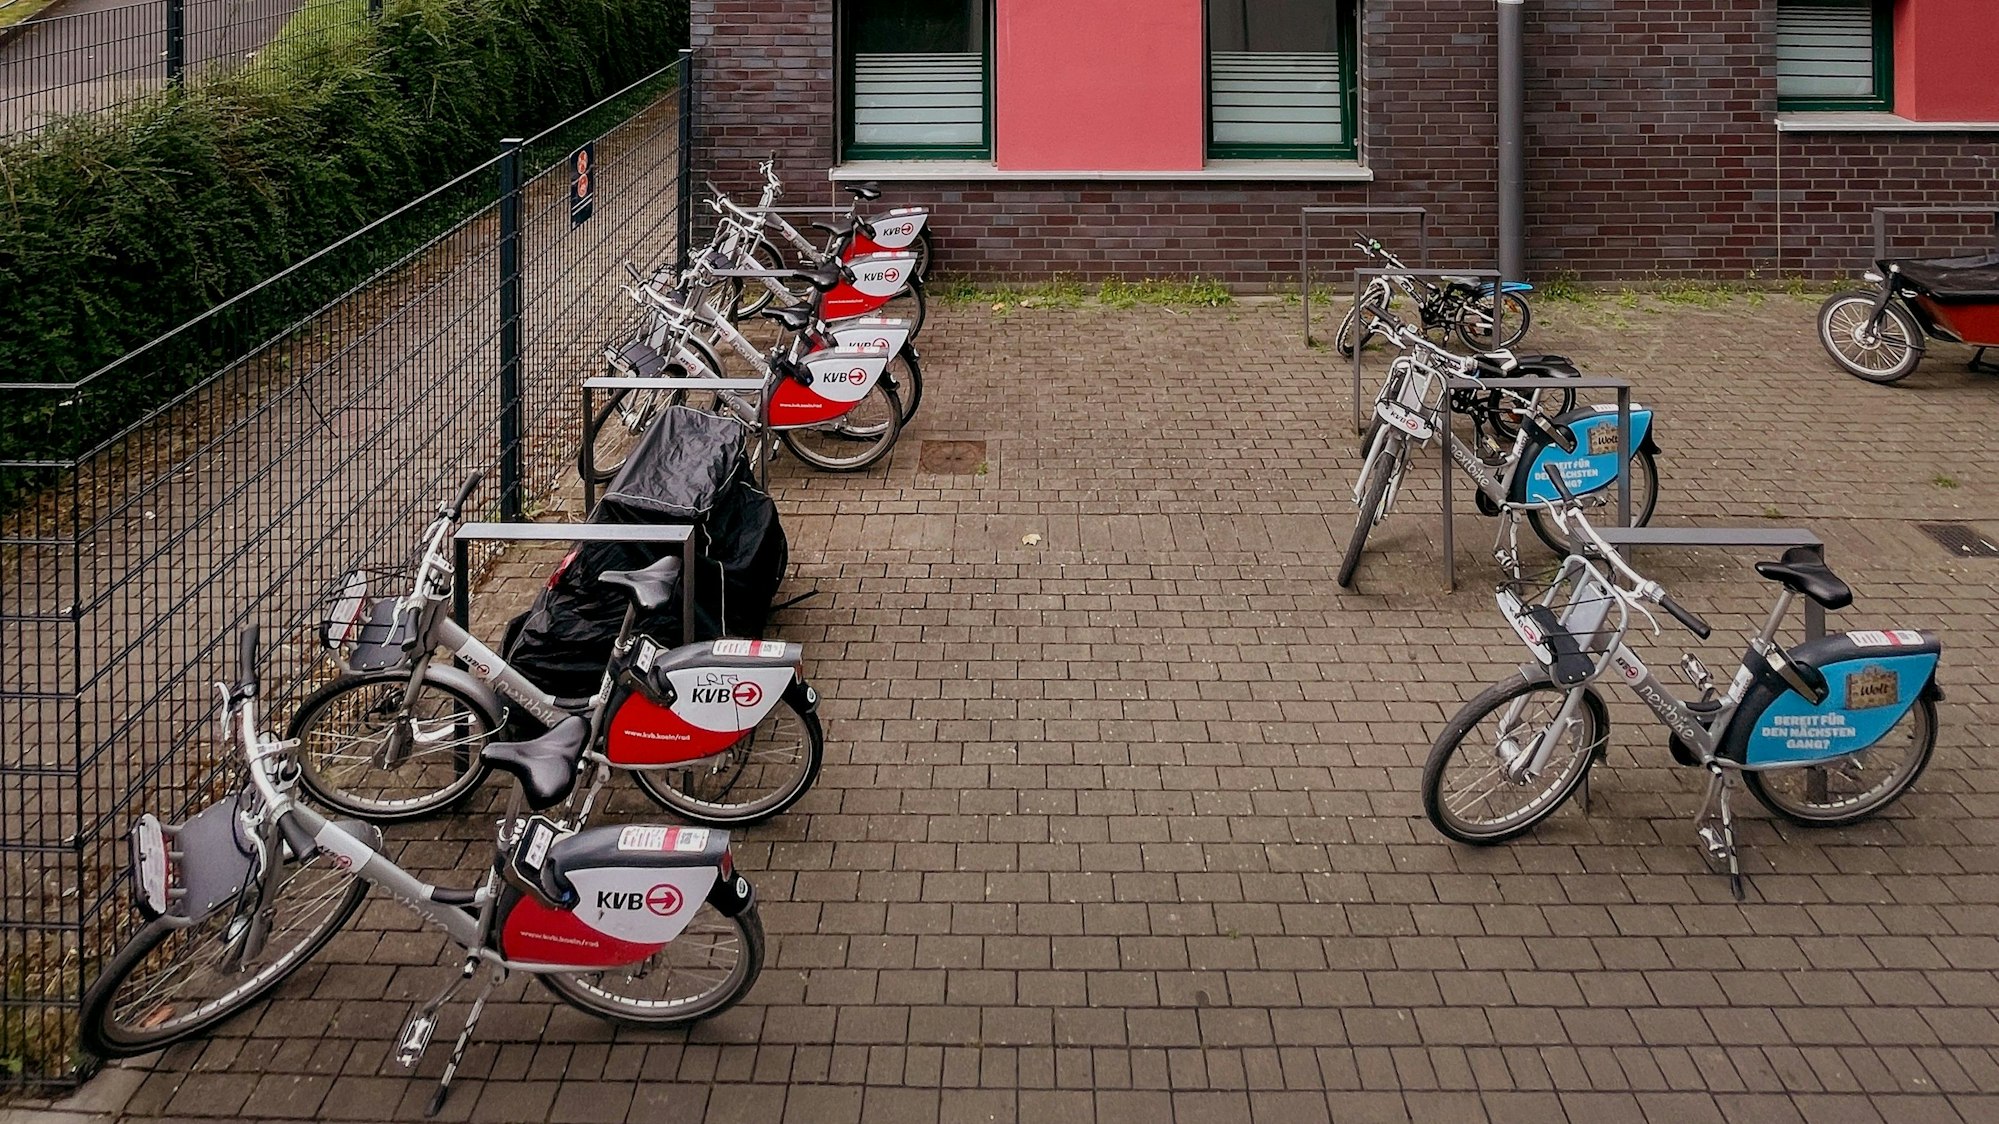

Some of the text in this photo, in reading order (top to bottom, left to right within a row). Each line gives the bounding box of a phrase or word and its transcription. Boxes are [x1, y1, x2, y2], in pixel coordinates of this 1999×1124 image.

[883, 227, 900, 236] KVB
[864, 272, 884, 281] KVB
[823, 372, 848, 382] KVB
[1450, 444, 1490, 487] nextbike
[692, 688, 730, 703] KVB
[1860, 683, 1888, 696] Wolt
[1639, 685, 1694, 739] nextbike
[1774, 712, 1845, 726] BEREIT FÜR
[1762, 725, 1856, 737] DEN NÄCHSTEN
[1786, 739, 1831, 749] GANG?
[597, 891, 643, 910] KVB
